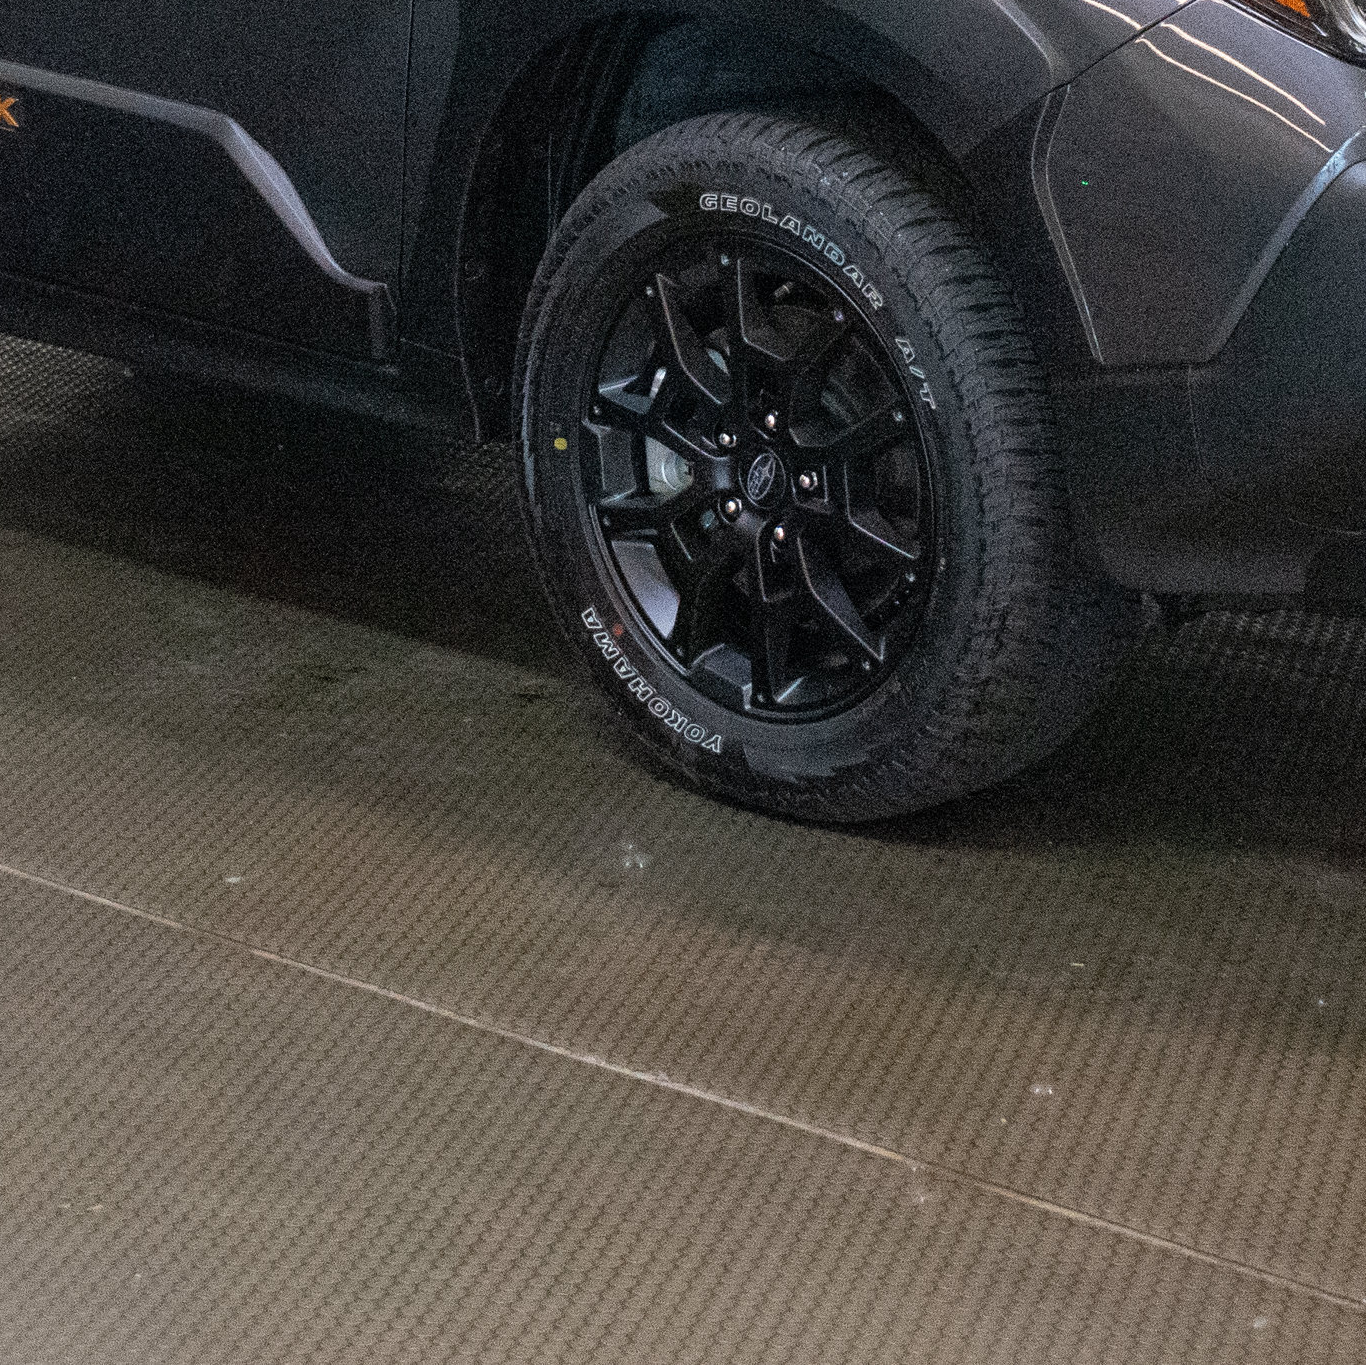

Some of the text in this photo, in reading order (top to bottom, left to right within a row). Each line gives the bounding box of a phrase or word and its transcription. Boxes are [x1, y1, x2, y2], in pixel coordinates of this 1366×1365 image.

[699, 193, 936, 409] GEOLANDAR A/T
[581, 607, 722, 753] YOKOHAMA
